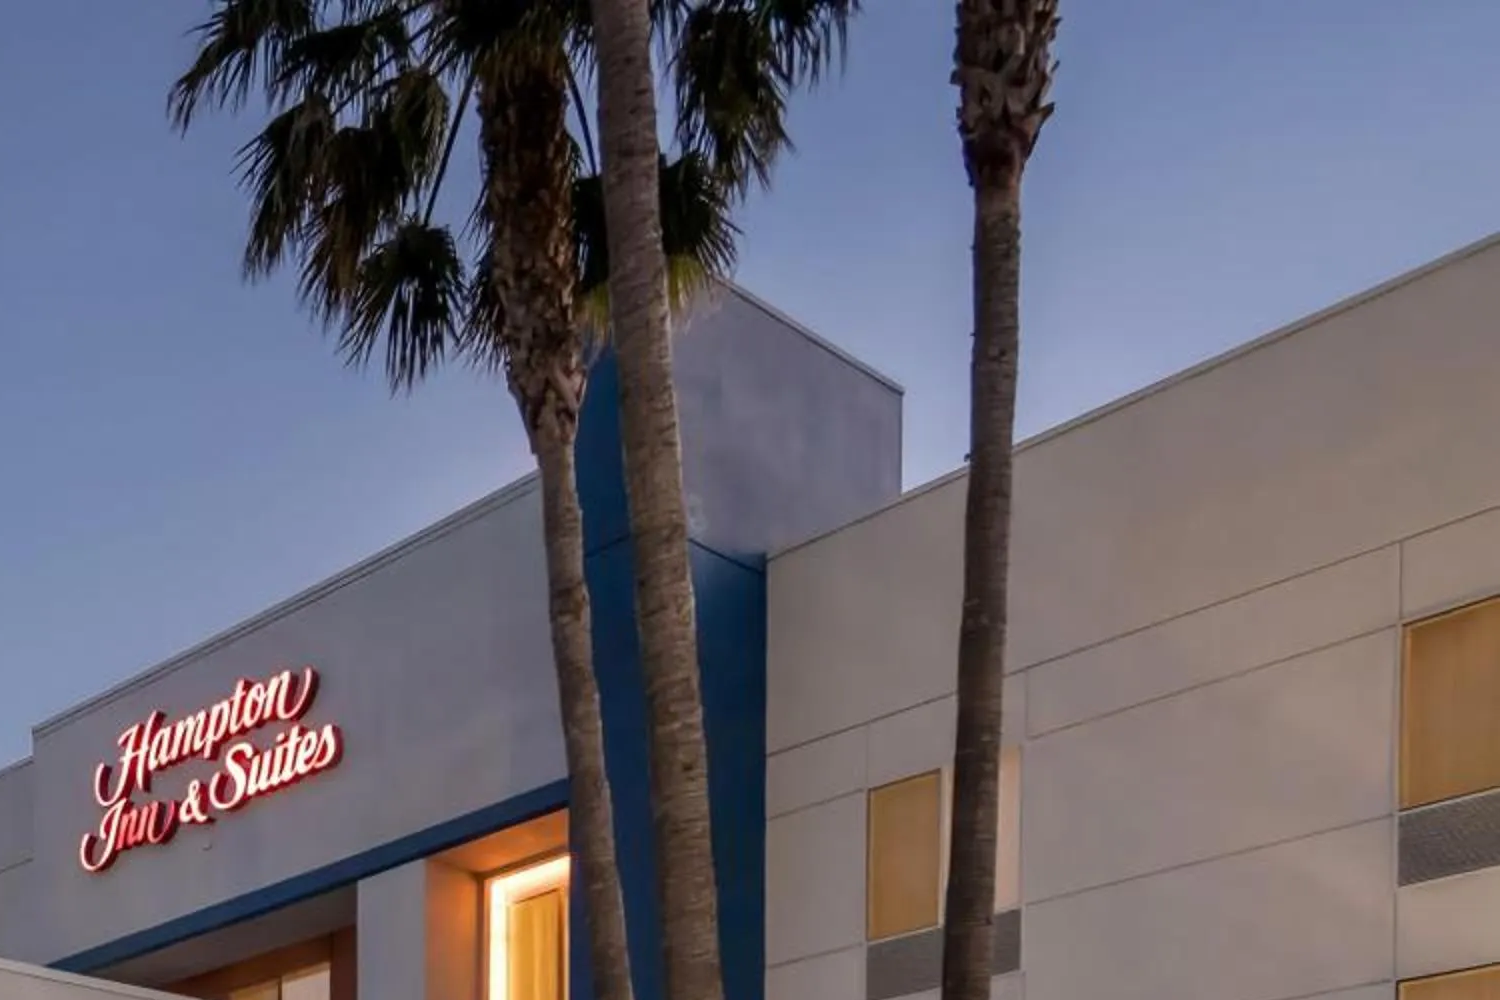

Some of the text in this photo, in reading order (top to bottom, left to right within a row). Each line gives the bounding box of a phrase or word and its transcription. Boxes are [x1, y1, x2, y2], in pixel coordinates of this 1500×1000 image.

[79, 724, 341, 873] Inn & Suites
[94, 665, 318, 808] Hampton
